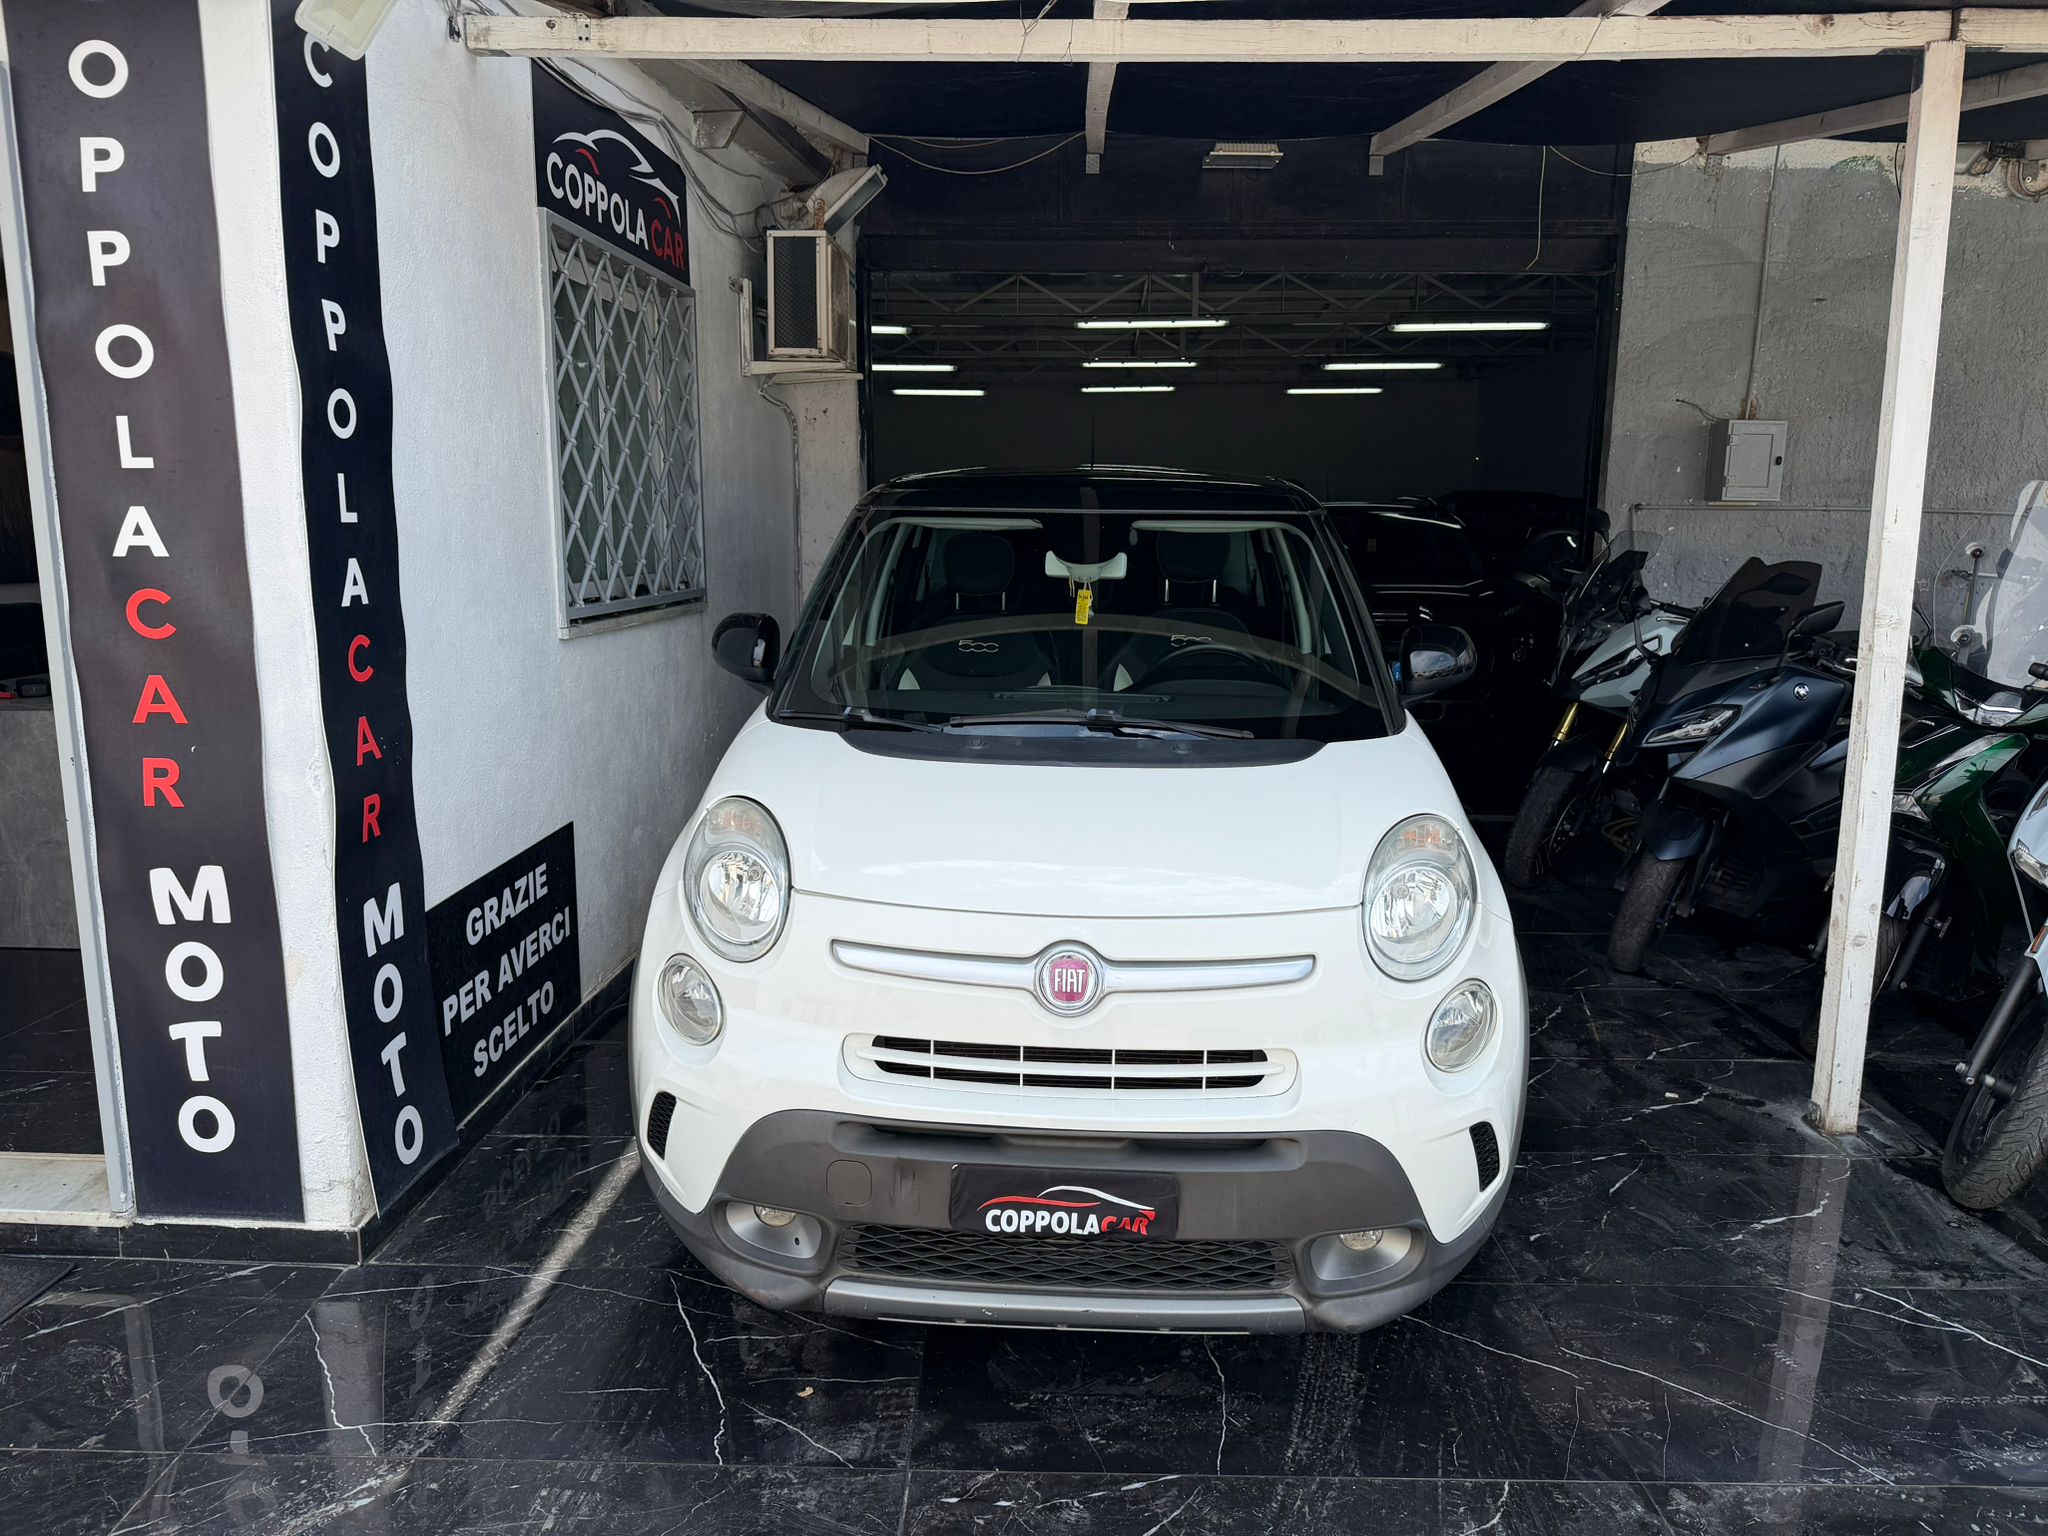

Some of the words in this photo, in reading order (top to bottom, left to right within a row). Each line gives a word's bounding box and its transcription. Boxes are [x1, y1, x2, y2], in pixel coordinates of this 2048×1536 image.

[465, 862, 548, 946] GRAZIE
[149, 865, 236, 1153] MOTO
[363, 883, 423, 1165] MOTO
[442, 969, 492, 1037] PER
[498, 905, 571, 993] AVERCI
[1054, 968, 1085, 993] FIAT
[473, 980, 554, 1078] SCELTO
